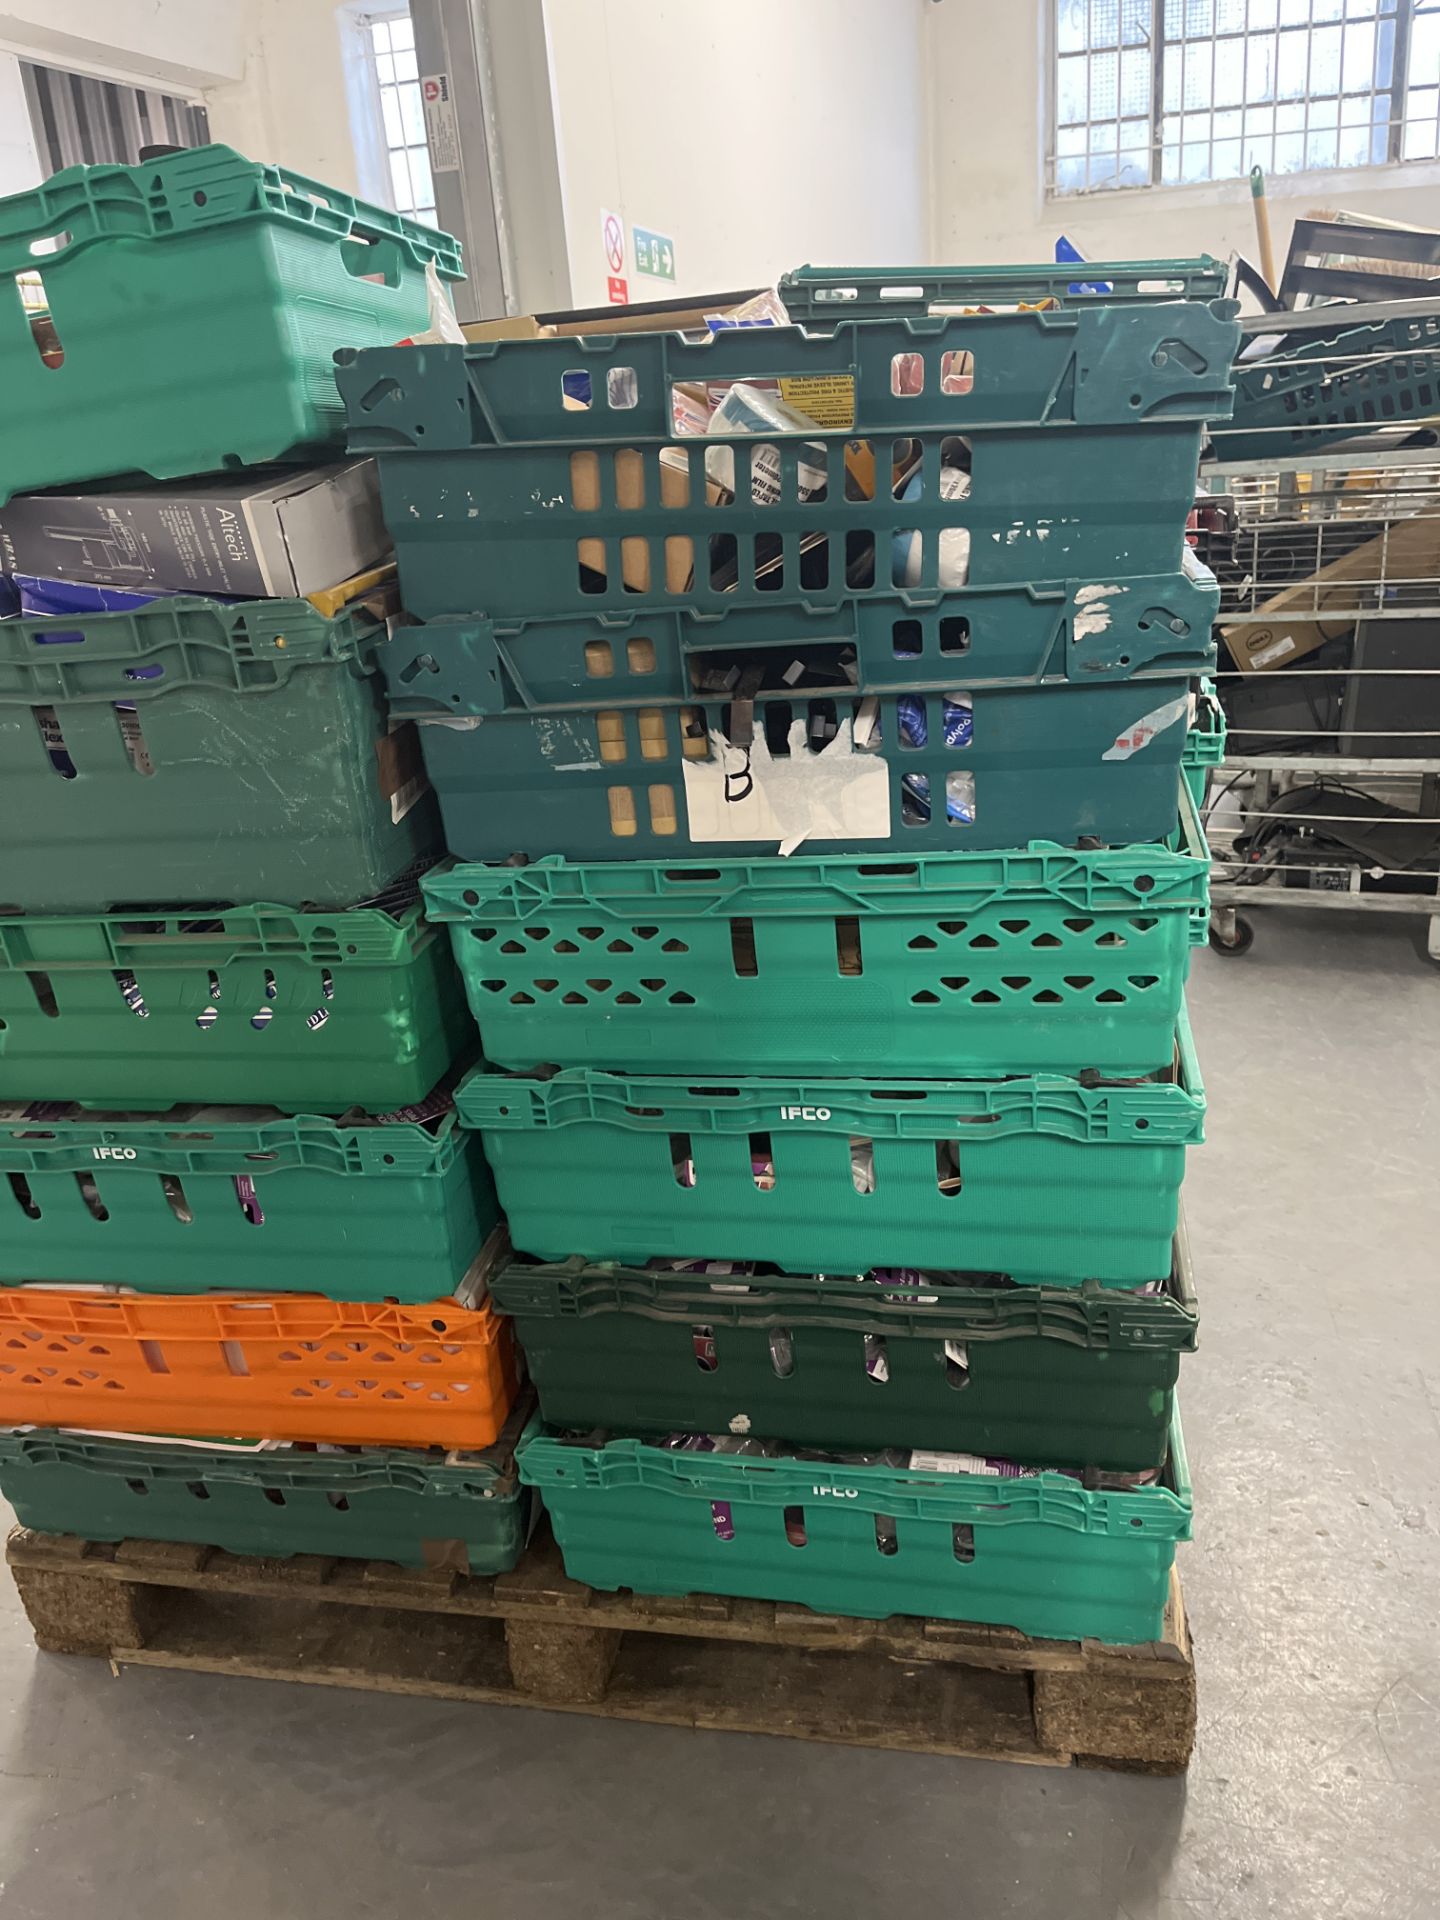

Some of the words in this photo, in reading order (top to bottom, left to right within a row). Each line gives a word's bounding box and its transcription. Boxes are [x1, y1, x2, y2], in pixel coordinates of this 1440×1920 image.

[216, 507, 243, 561] Altech
[780, 1106, 831, 1120] IFCO
[93, 1147, 136, 1160] IFCO
